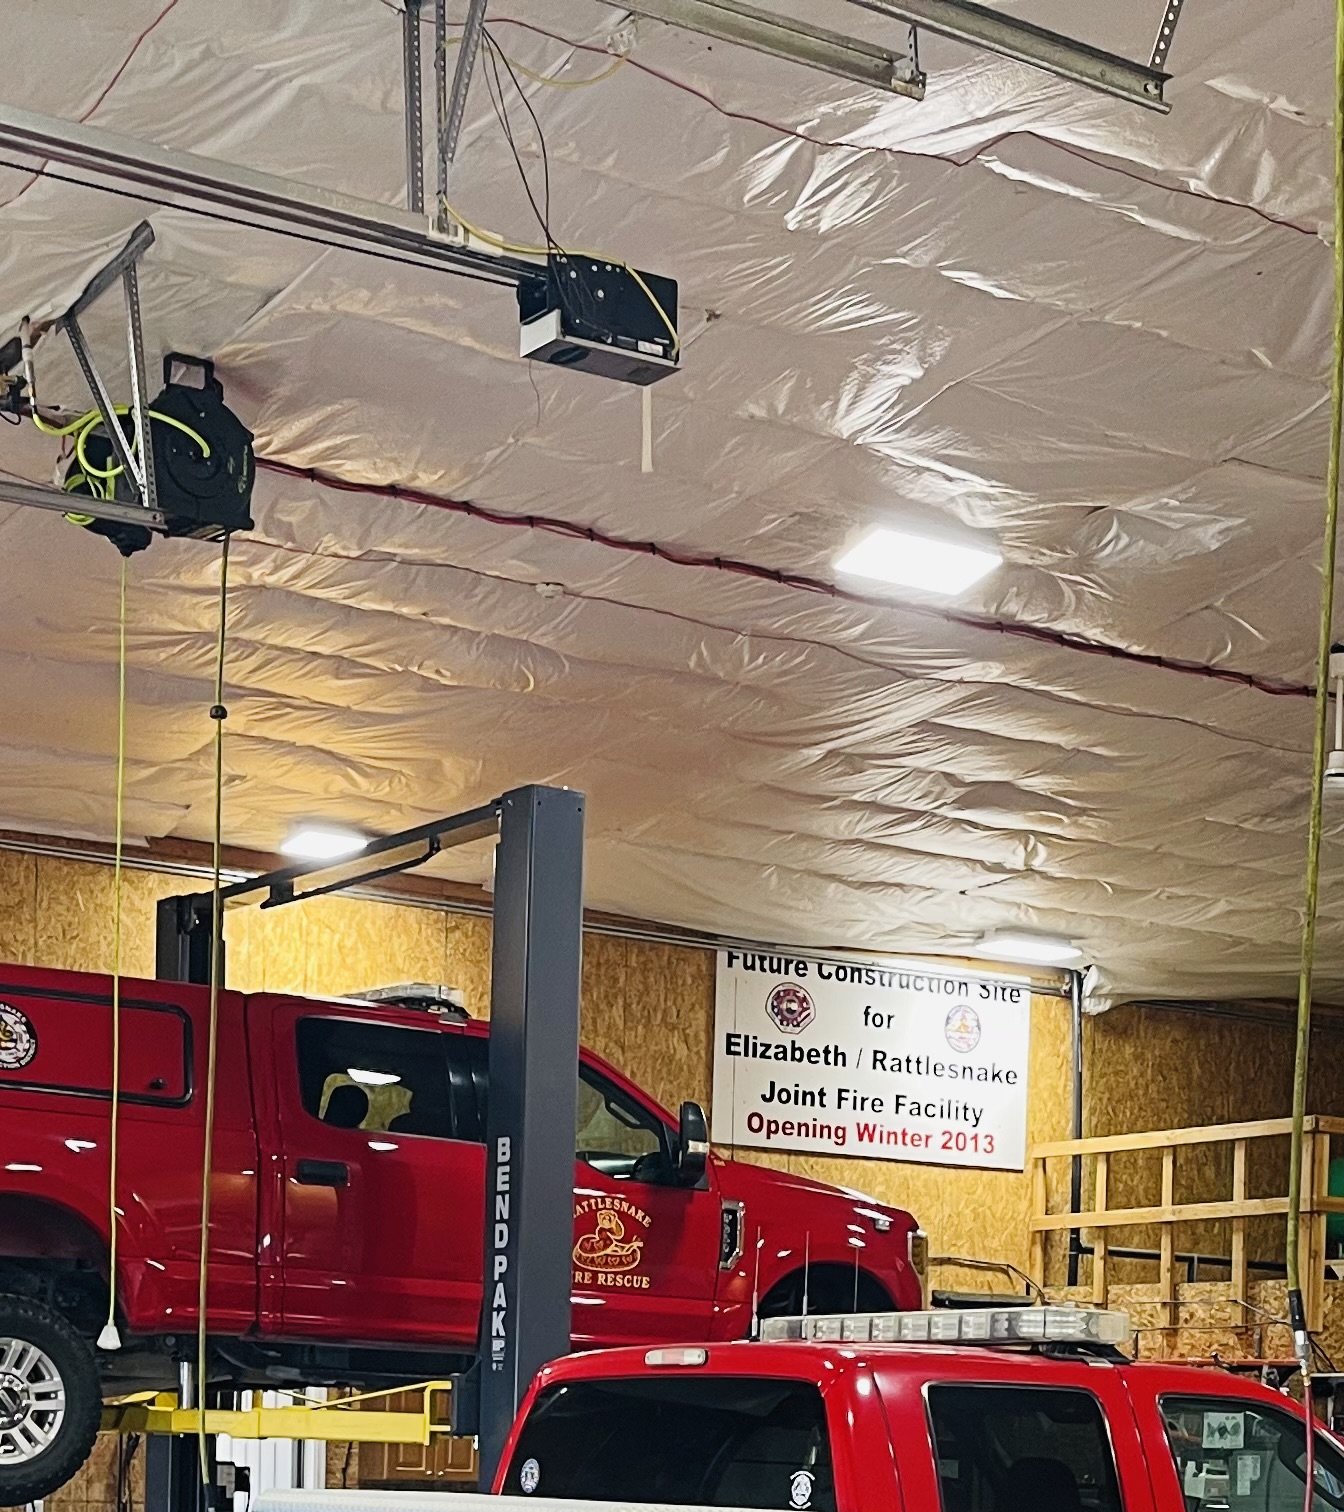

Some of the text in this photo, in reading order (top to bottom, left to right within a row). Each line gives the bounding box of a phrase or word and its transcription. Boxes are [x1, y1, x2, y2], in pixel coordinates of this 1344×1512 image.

[726, 950, 809, 978] Future
[816, 962, 970, 998] Construction
[863, 1005, 895, 1030] for
[725, 1032, 1019, 1086] Elizabeth / Rattlesnake
[760, 1080, 985, 1128] Joint Fire Facility
[746, 1111, 996, 1154] Opening Winter 2013
[573, 1197, 652, 1228] ATTLESNAKE
[573, 1271, 651, 1289] RE RESCUE
